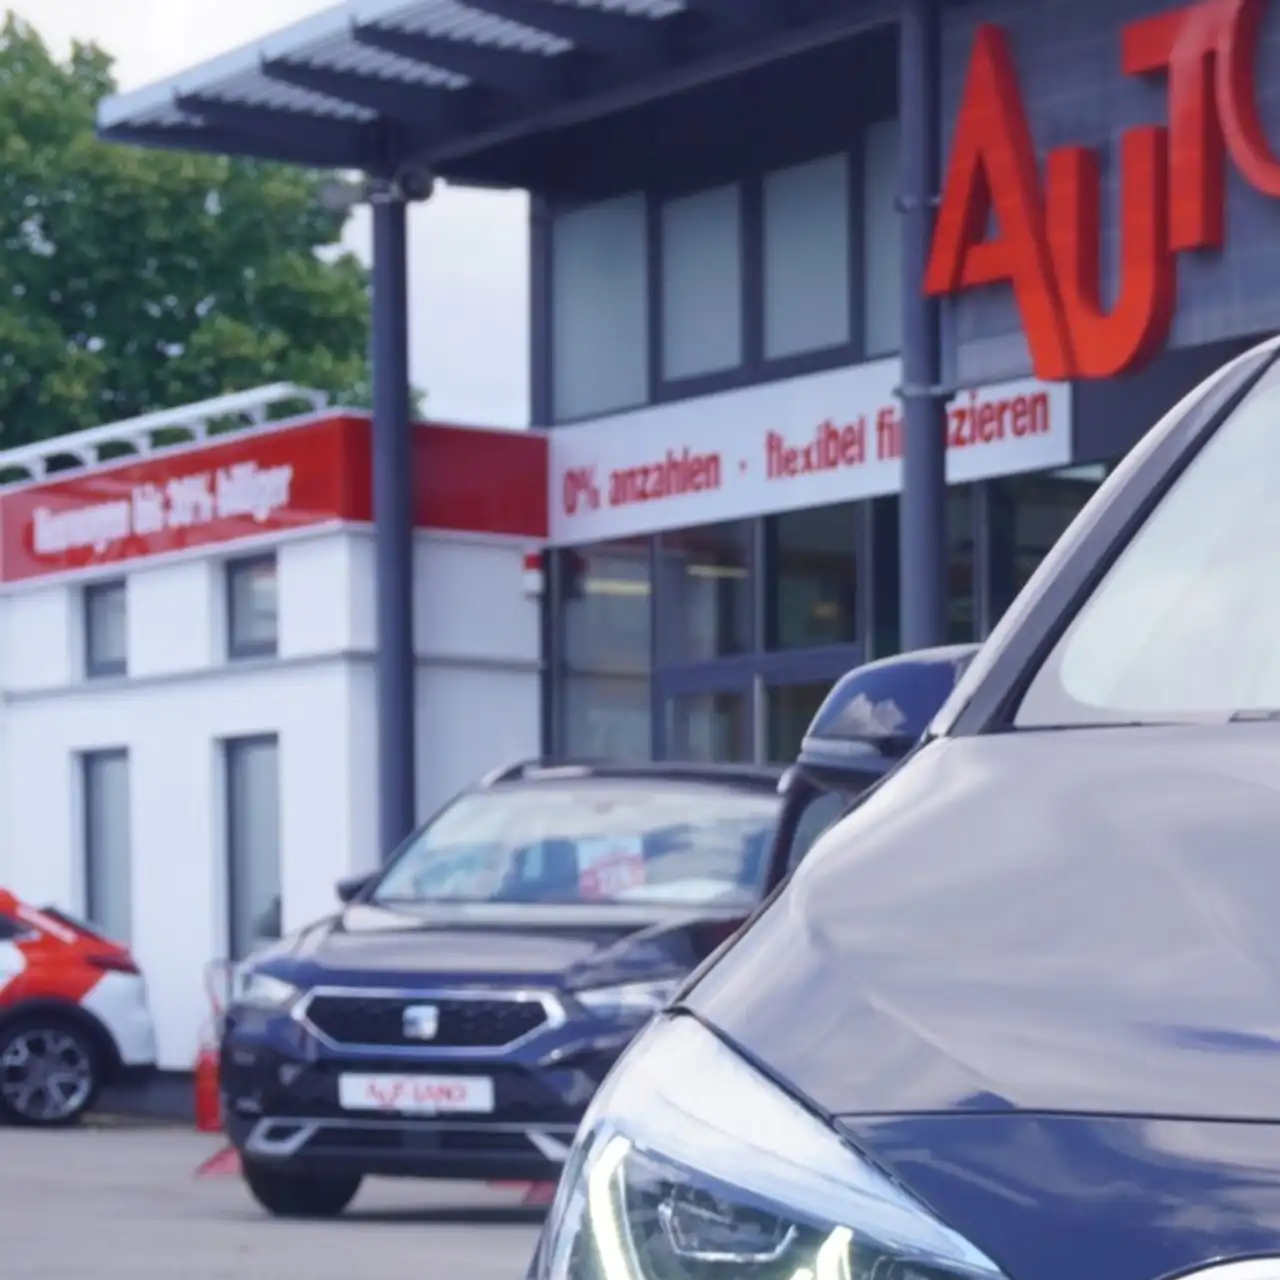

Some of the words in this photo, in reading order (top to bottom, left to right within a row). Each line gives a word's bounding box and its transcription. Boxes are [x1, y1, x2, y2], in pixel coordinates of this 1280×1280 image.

[609, 446, 721, 506] anzahlen
[765, 413, 866, 481] flexibel
[876, 388, 1050, 461] fizieren
